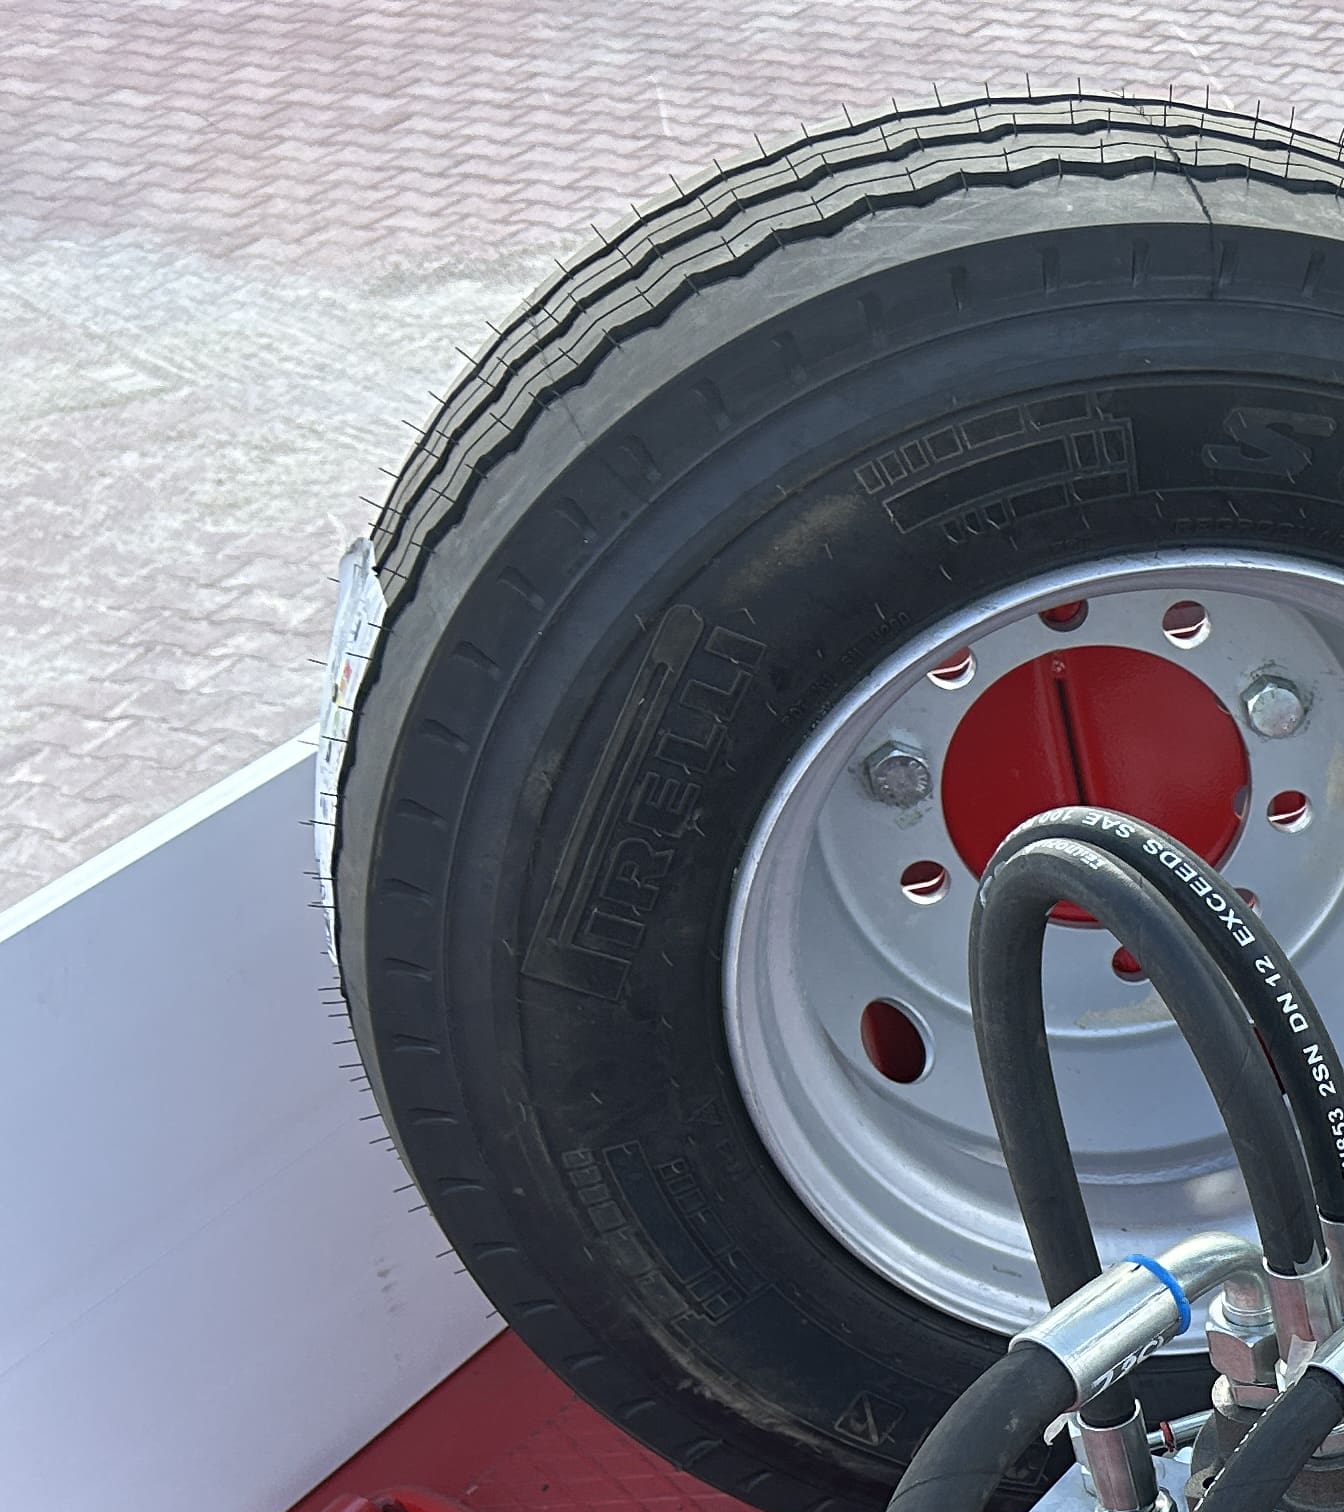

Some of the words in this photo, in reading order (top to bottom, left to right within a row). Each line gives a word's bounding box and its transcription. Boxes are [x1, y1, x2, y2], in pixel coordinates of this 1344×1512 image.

[521, 605, 767, 1000] PIRELLI
[1082, 811, 1136, 839] SAE
[1142, 839, 1256, 948] EXCEEDS
[1254, 955, 1283, 988] 12
[1276, 992, 1310, 1034] DN
[1303, 1046, 1337, 1098] 2SN
